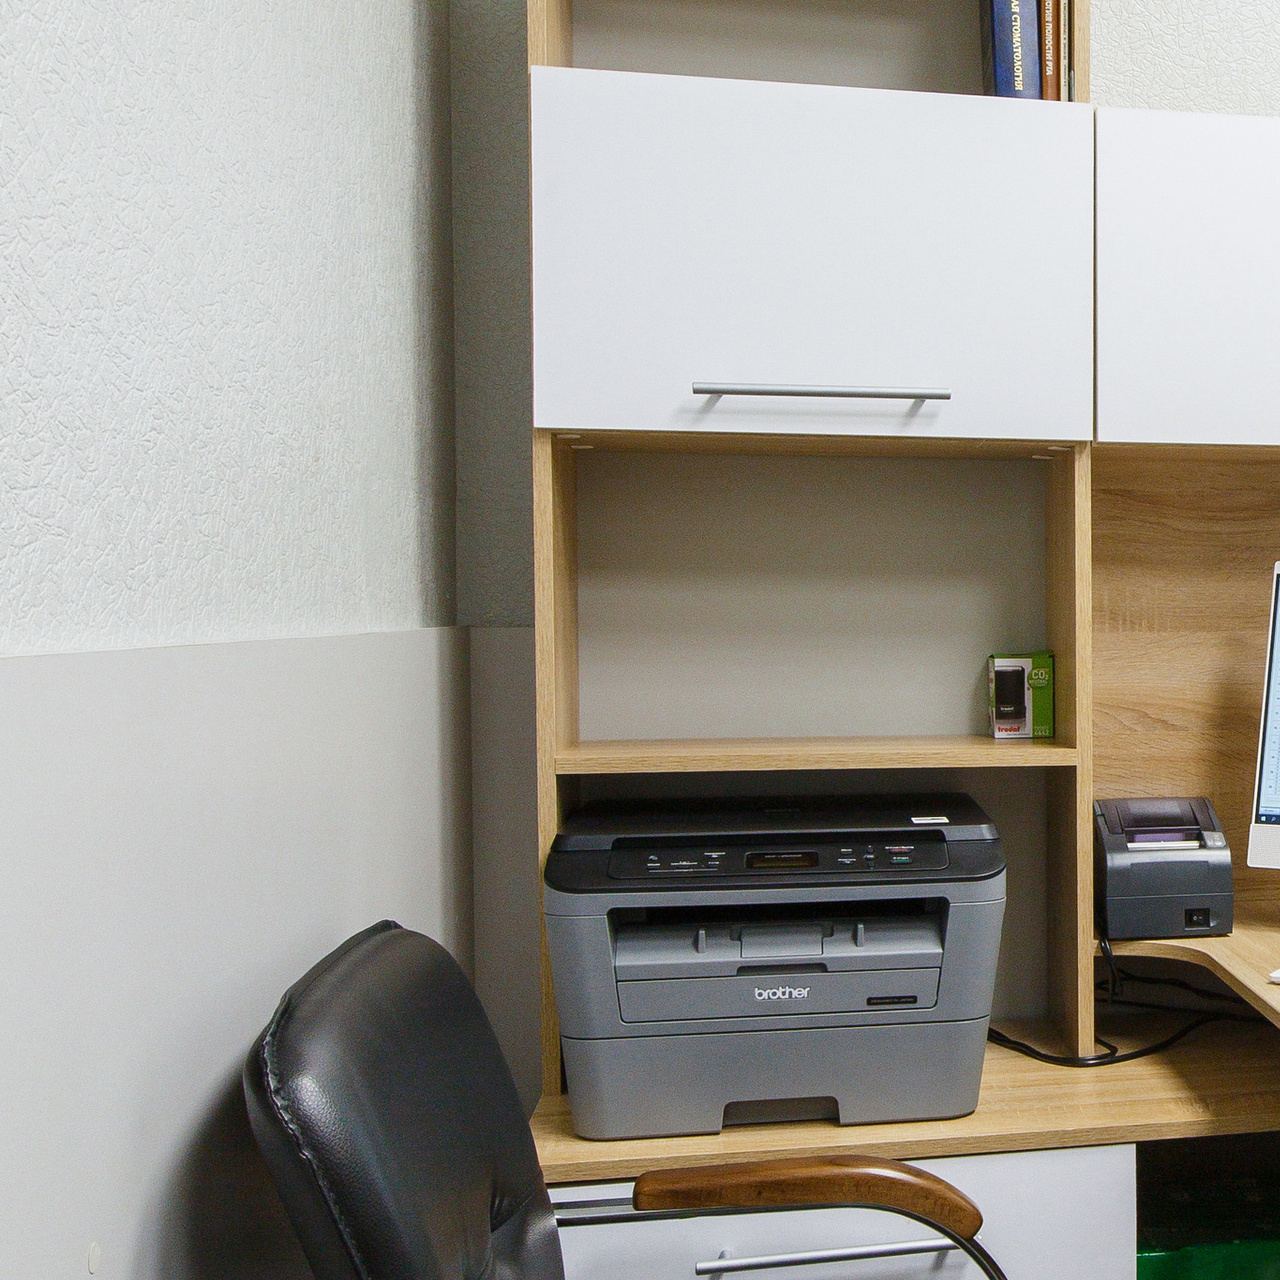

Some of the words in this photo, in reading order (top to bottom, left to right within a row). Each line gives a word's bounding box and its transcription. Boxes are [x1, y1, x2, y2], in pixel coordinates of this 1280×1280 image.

[1012, 15, 1023, 90] СТОМАТОЛОГИЯ
[1045, 23, 1053, 59] ПОЛОСТИ
[754, 986, 810, 1000] brother
